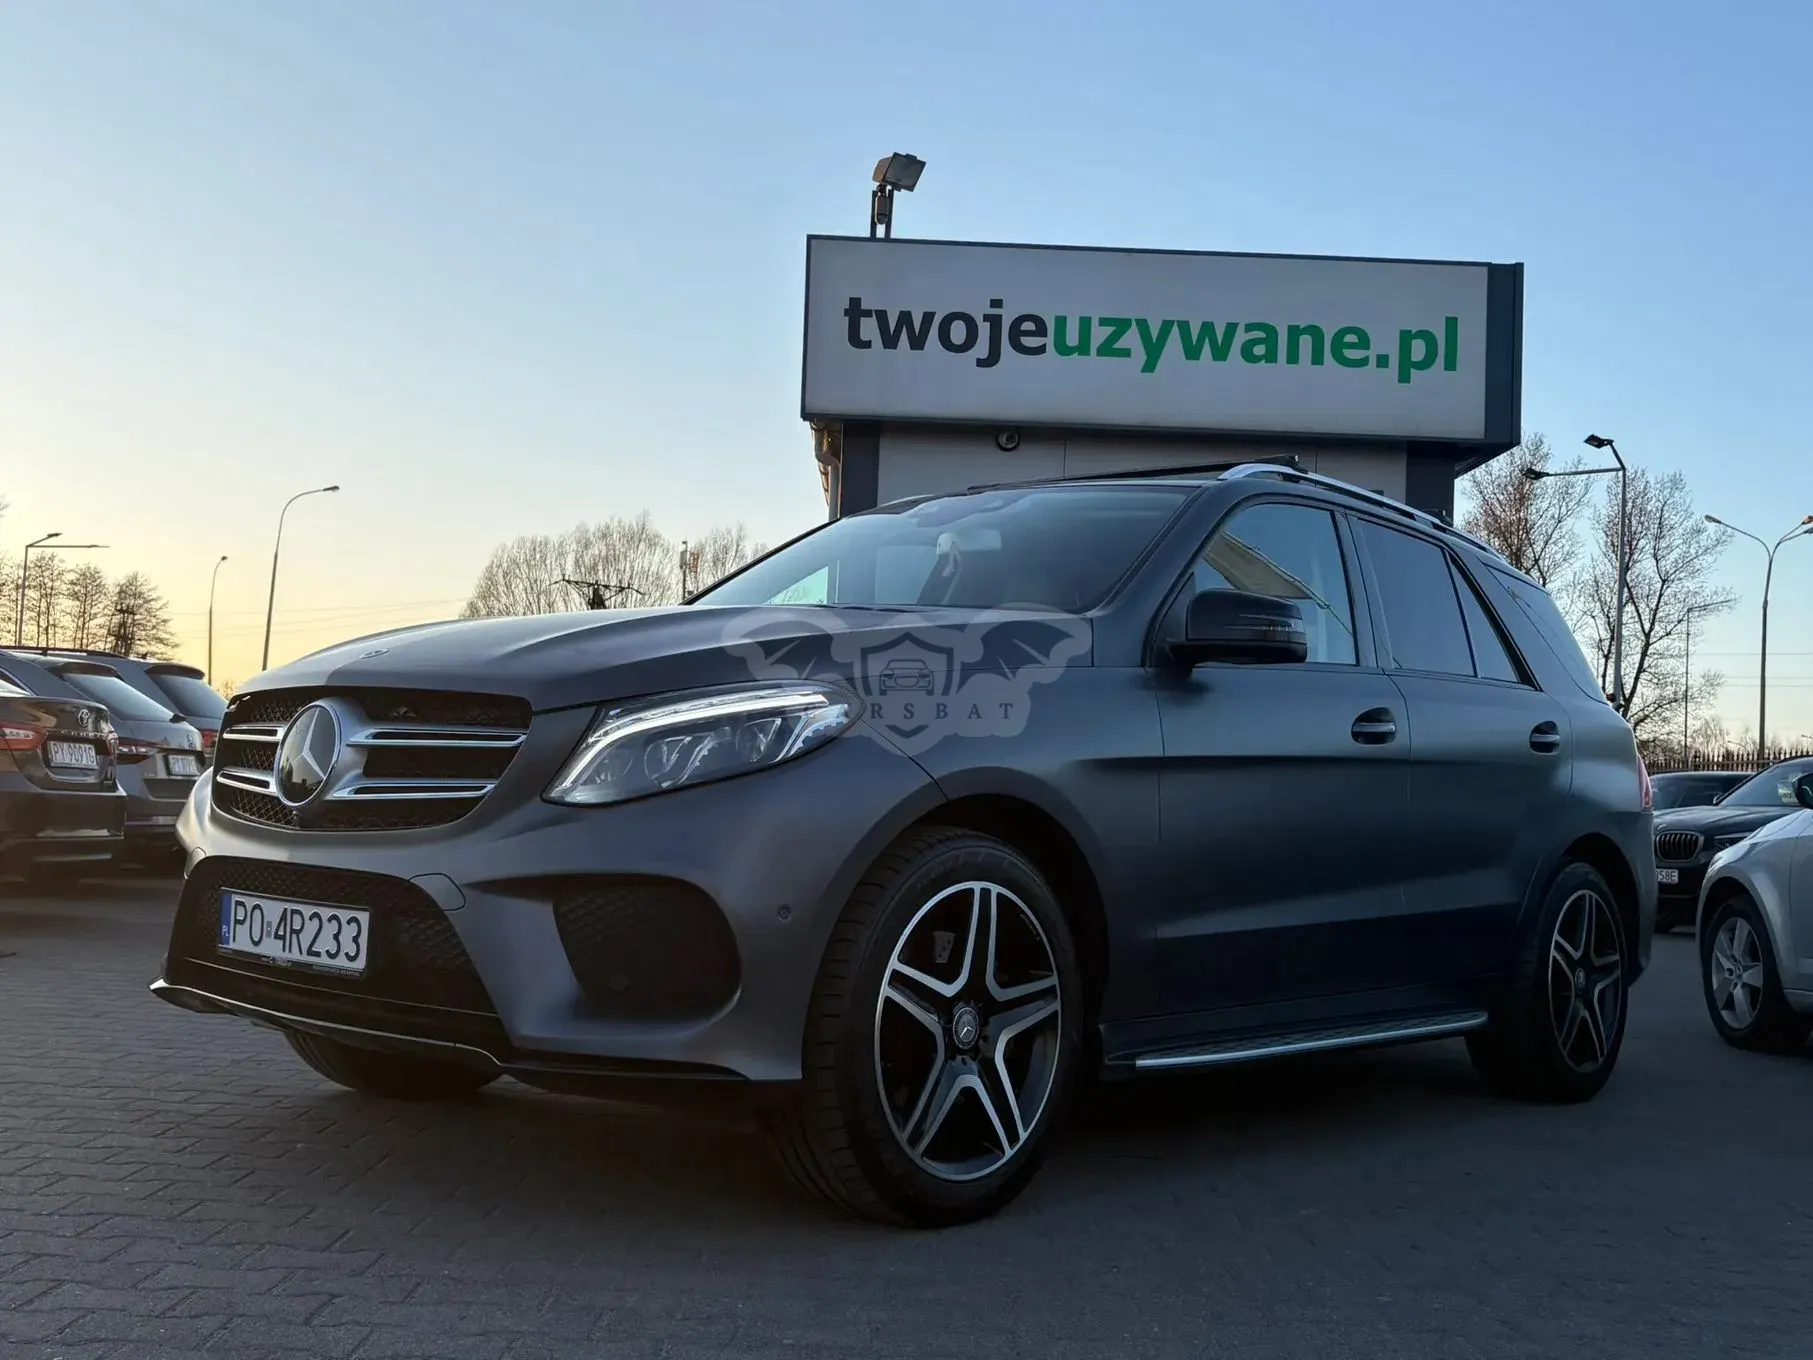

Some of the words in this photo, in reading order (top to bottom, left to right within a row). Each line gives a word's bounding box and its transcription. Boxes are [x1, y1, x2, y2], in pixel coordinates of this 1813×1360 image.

[844, 297, 1459, 384] twojeuzywane.pl
[221, 925, 229, 937] PL
[232, 899, 265, 947] PO
[273, 907, 362, 962] 4R233
